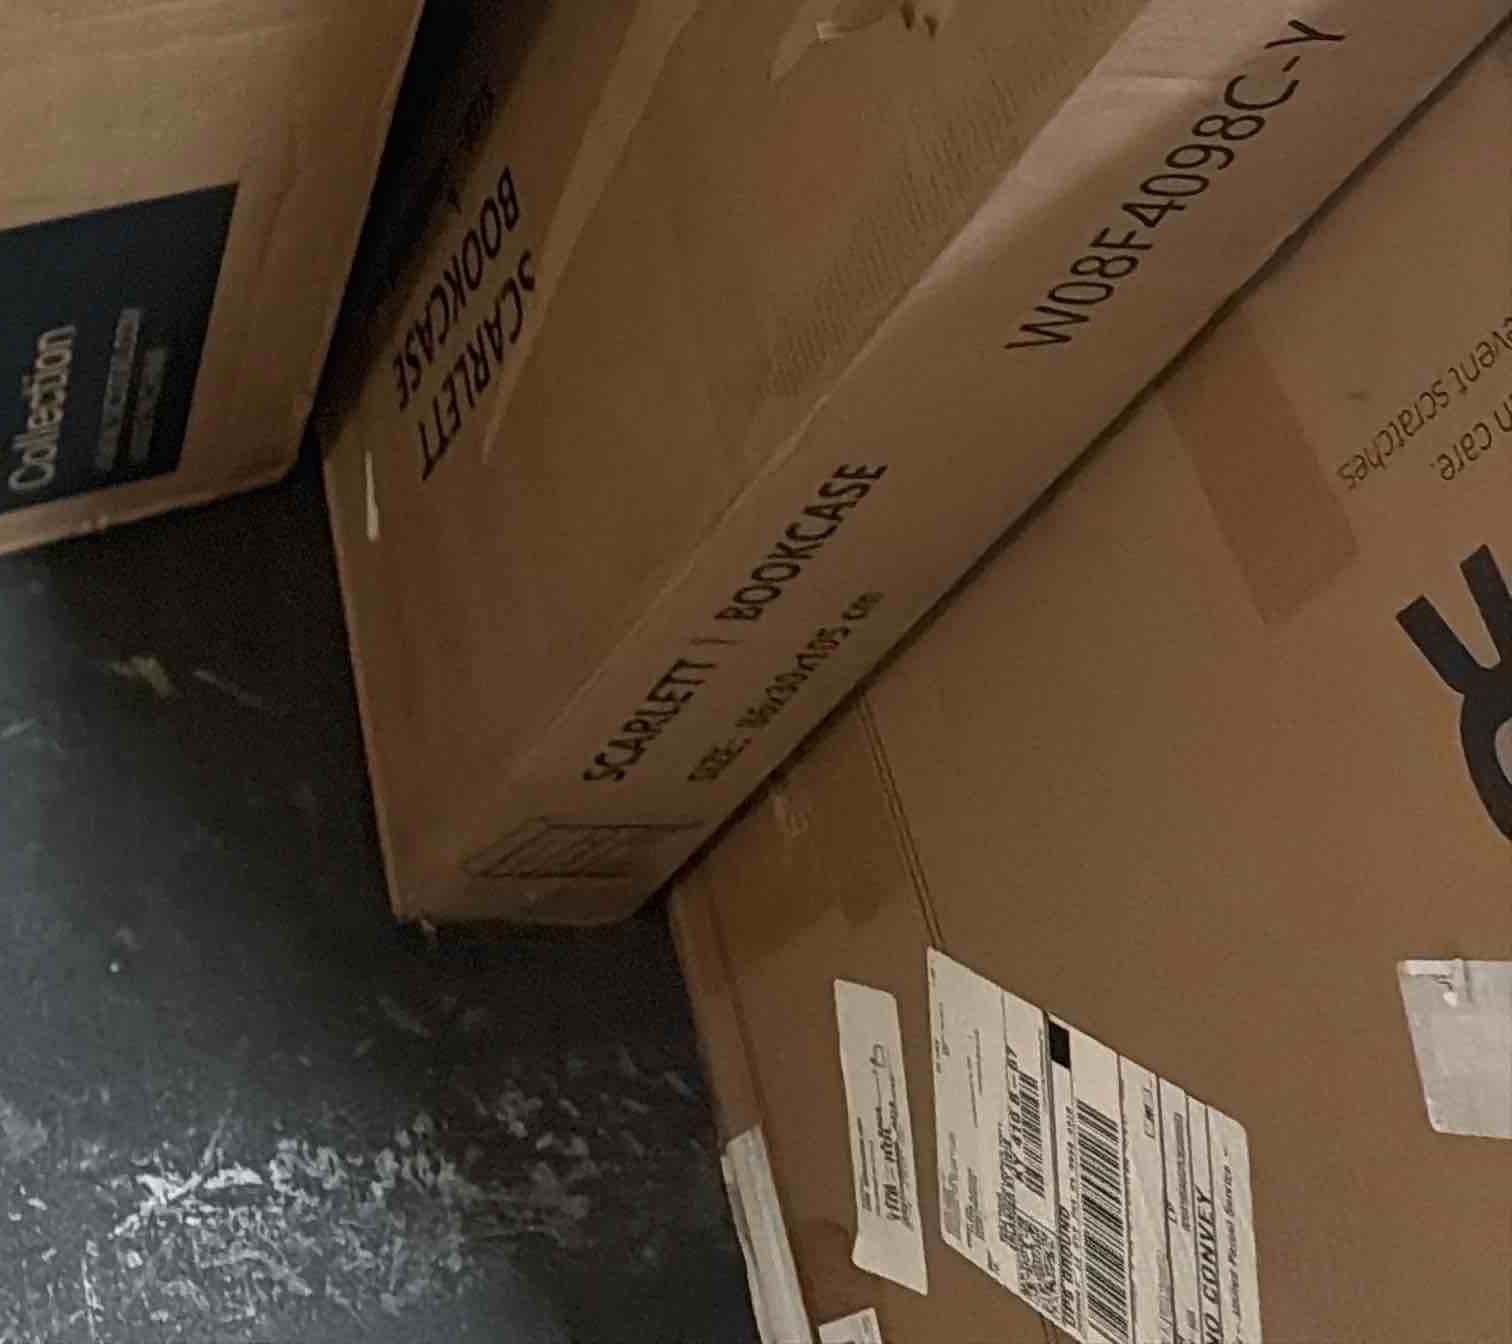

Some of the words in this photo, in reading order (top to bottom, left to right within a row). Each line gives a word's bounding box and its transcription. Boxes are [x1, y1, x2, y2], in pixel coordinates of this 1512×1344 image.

[1003, 18, 1346, 350] W08F4098C-Y
[392, 167, 521, 411] BOOKCASE
[7, 323, 77, 491] Collection
[1336, 379, 1450, 491] scratches
[1429, 421, 1493, 482] care.
[583, 657, 718, 782] SCARLETT
[713, 463, 889, 622] BOOKCASE
[1194, 1184, 1220, 1305] CONVEY
